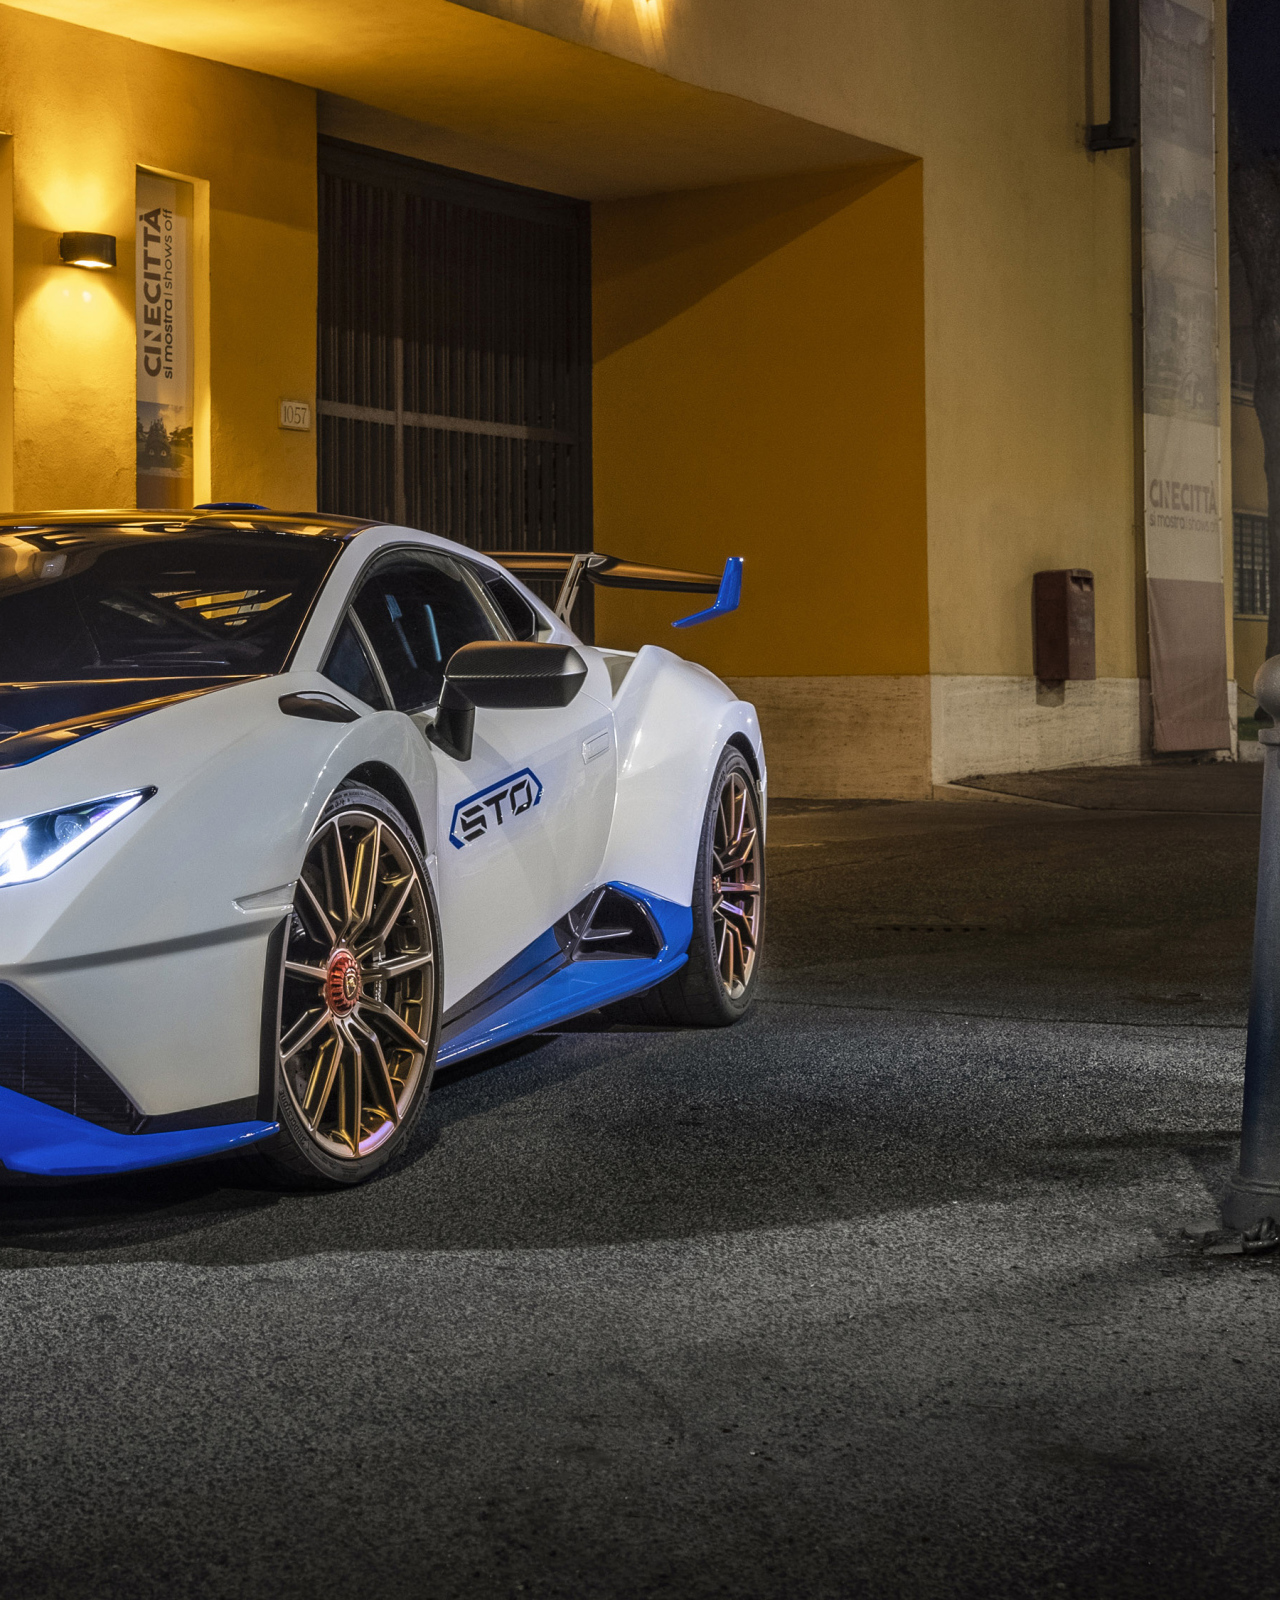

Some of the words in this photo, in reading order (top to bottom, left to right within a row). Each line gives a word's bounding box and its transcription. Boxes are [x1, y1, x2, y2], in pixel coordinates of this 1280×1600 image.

[163, 208, 173, 232] off
[163, 235, 173, 289] shows
[139, 207, 162, 377] CINECITTÀ
[163, 299, 173, 362] mostra
[163, 366, 173, 379] si
[284, 405, 307, 425] 1057
[460, 779, 533, 842] STO
